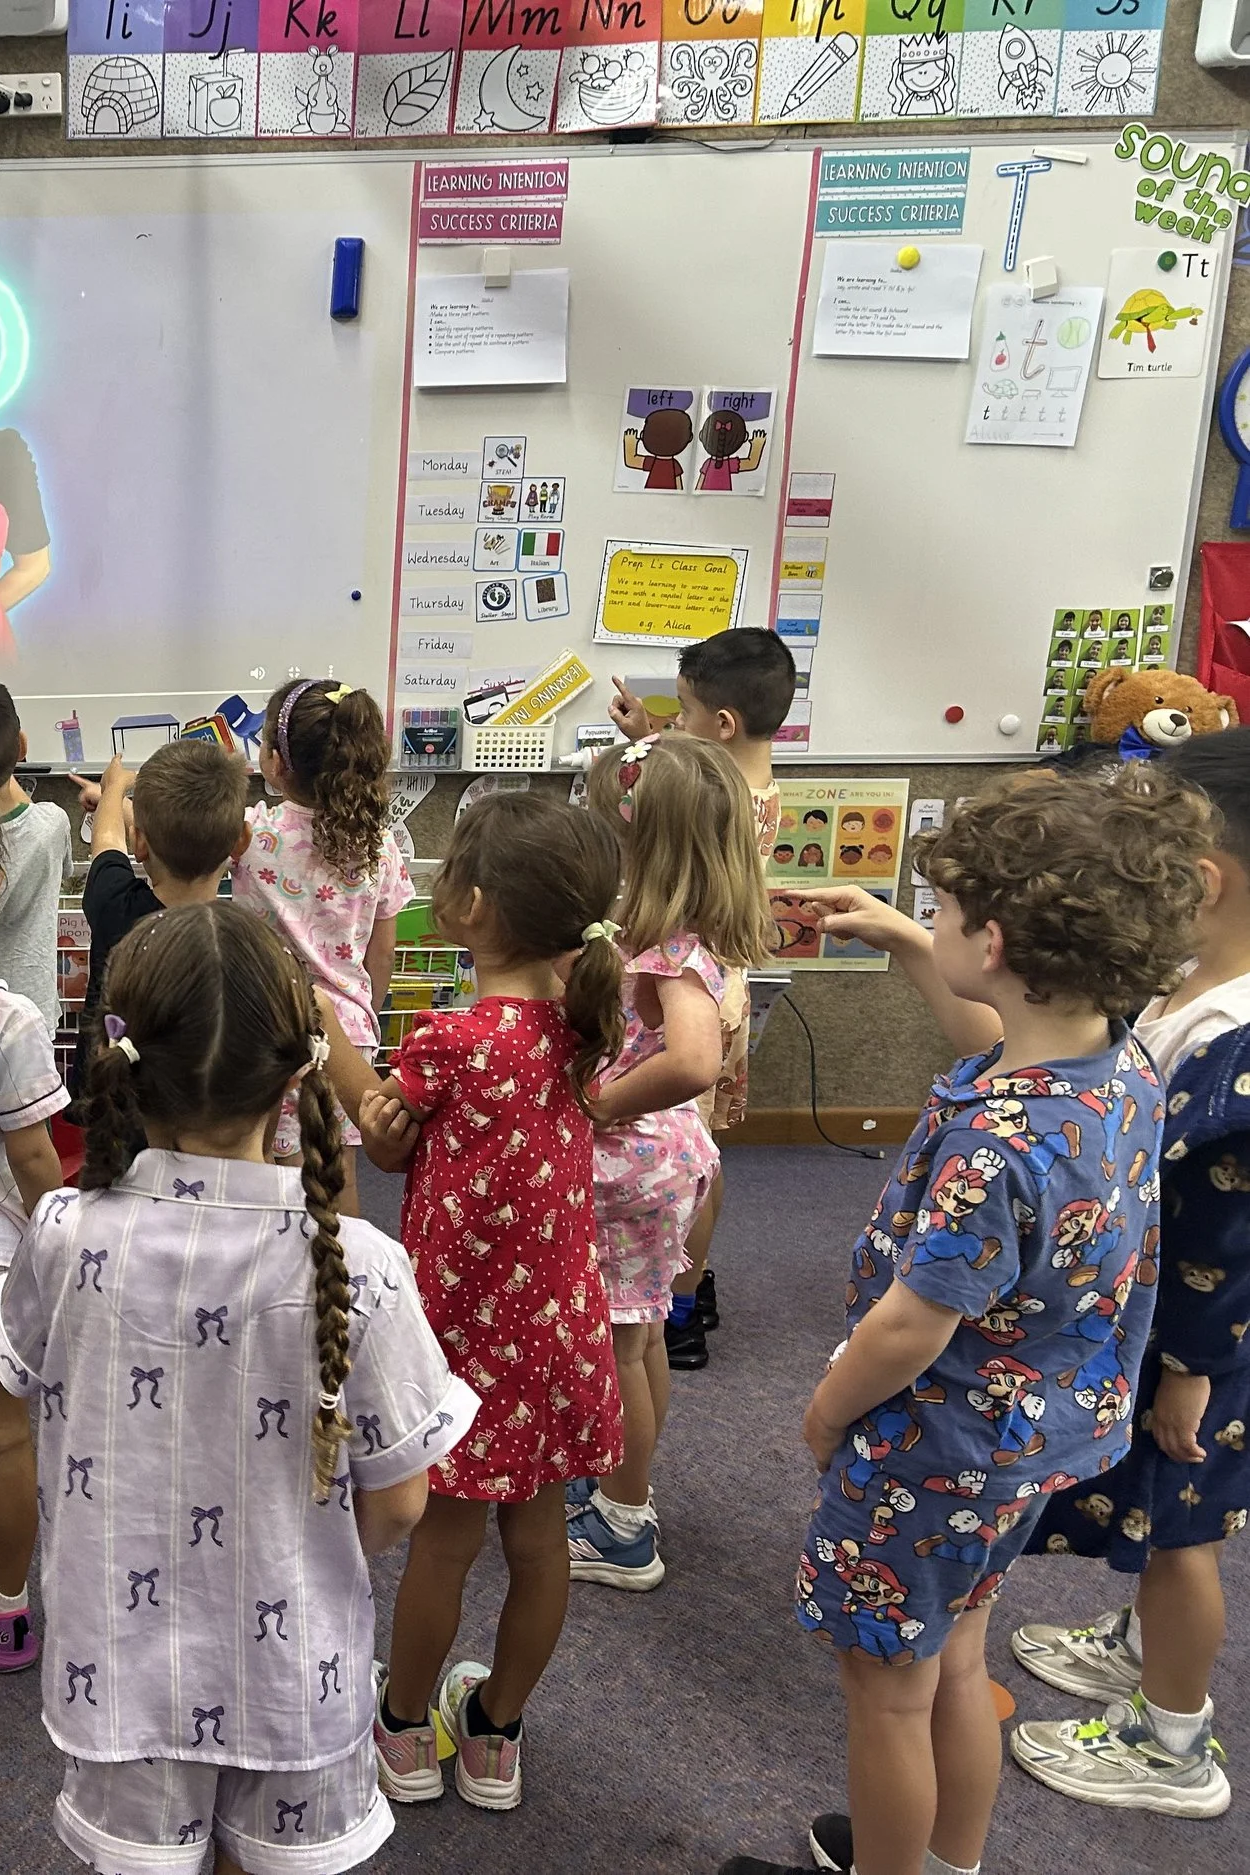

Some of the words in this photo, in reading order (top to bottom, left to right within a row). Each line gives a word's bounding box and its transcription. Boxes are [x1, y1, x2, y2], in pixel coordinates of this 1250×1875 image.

[284, 0, 338, 38] Kk
[468, 0, 562, 35] Mm
[580, 0, 646, 31] Nn
[824, 161, 892, 181] LEARNING
[897, 160, 968, 180] INTENTION
[428, 172, 493, 192] LEARNING
[498, 170, 567, 191] INTENTION
[1136, 177, 1176, 203] of
[1183, 187, 1232, 230] the
[828, 205, 895, 223] SUCCESS
[900, 203, 960, 222] CRITERIA
[997, 160, 1053, 272] T
[430, 213, 495, 231] SUCCESS
[500, 213, 558, 231] CRITERIA
[1134, 201, 1218, 244] week
[1182, 253, 1210, 278] Tt
[1128, 362, 1145, 372] Tim
[1148, 362, 1173, 372] turtle
[647, 390, 674, 407] left
[722, 393, 756, 411] right
[422, 457, 469, 473] Monday
[418, 504, 465, 519] Tuesday
[407, 550, 470, 567] Wednesday
[621, 556, 643, 571] Prep
[651, 558, 664, 569] L's
[671, 560, 697, 572] Class
[704, 563, 728, 574] Goal
[649, 580, 676, 591] learning
[409, 596, 464, 611] Thursday
[661, 592, 682, 601] capital
[537, 606, 559, 614] Library
[645, 602, 681, 610] lower-case
[686, 604, 706, 612] letters
[664, 620, 692, 631] Alicia
[418, 638, 455, 654] Friday
[404, 675, 457, 689] Saturday
[529, 663, 582, 710] LEARNING
[806, 788, 848, 800] ZONE
[59, 918, 78, 930] Pig
